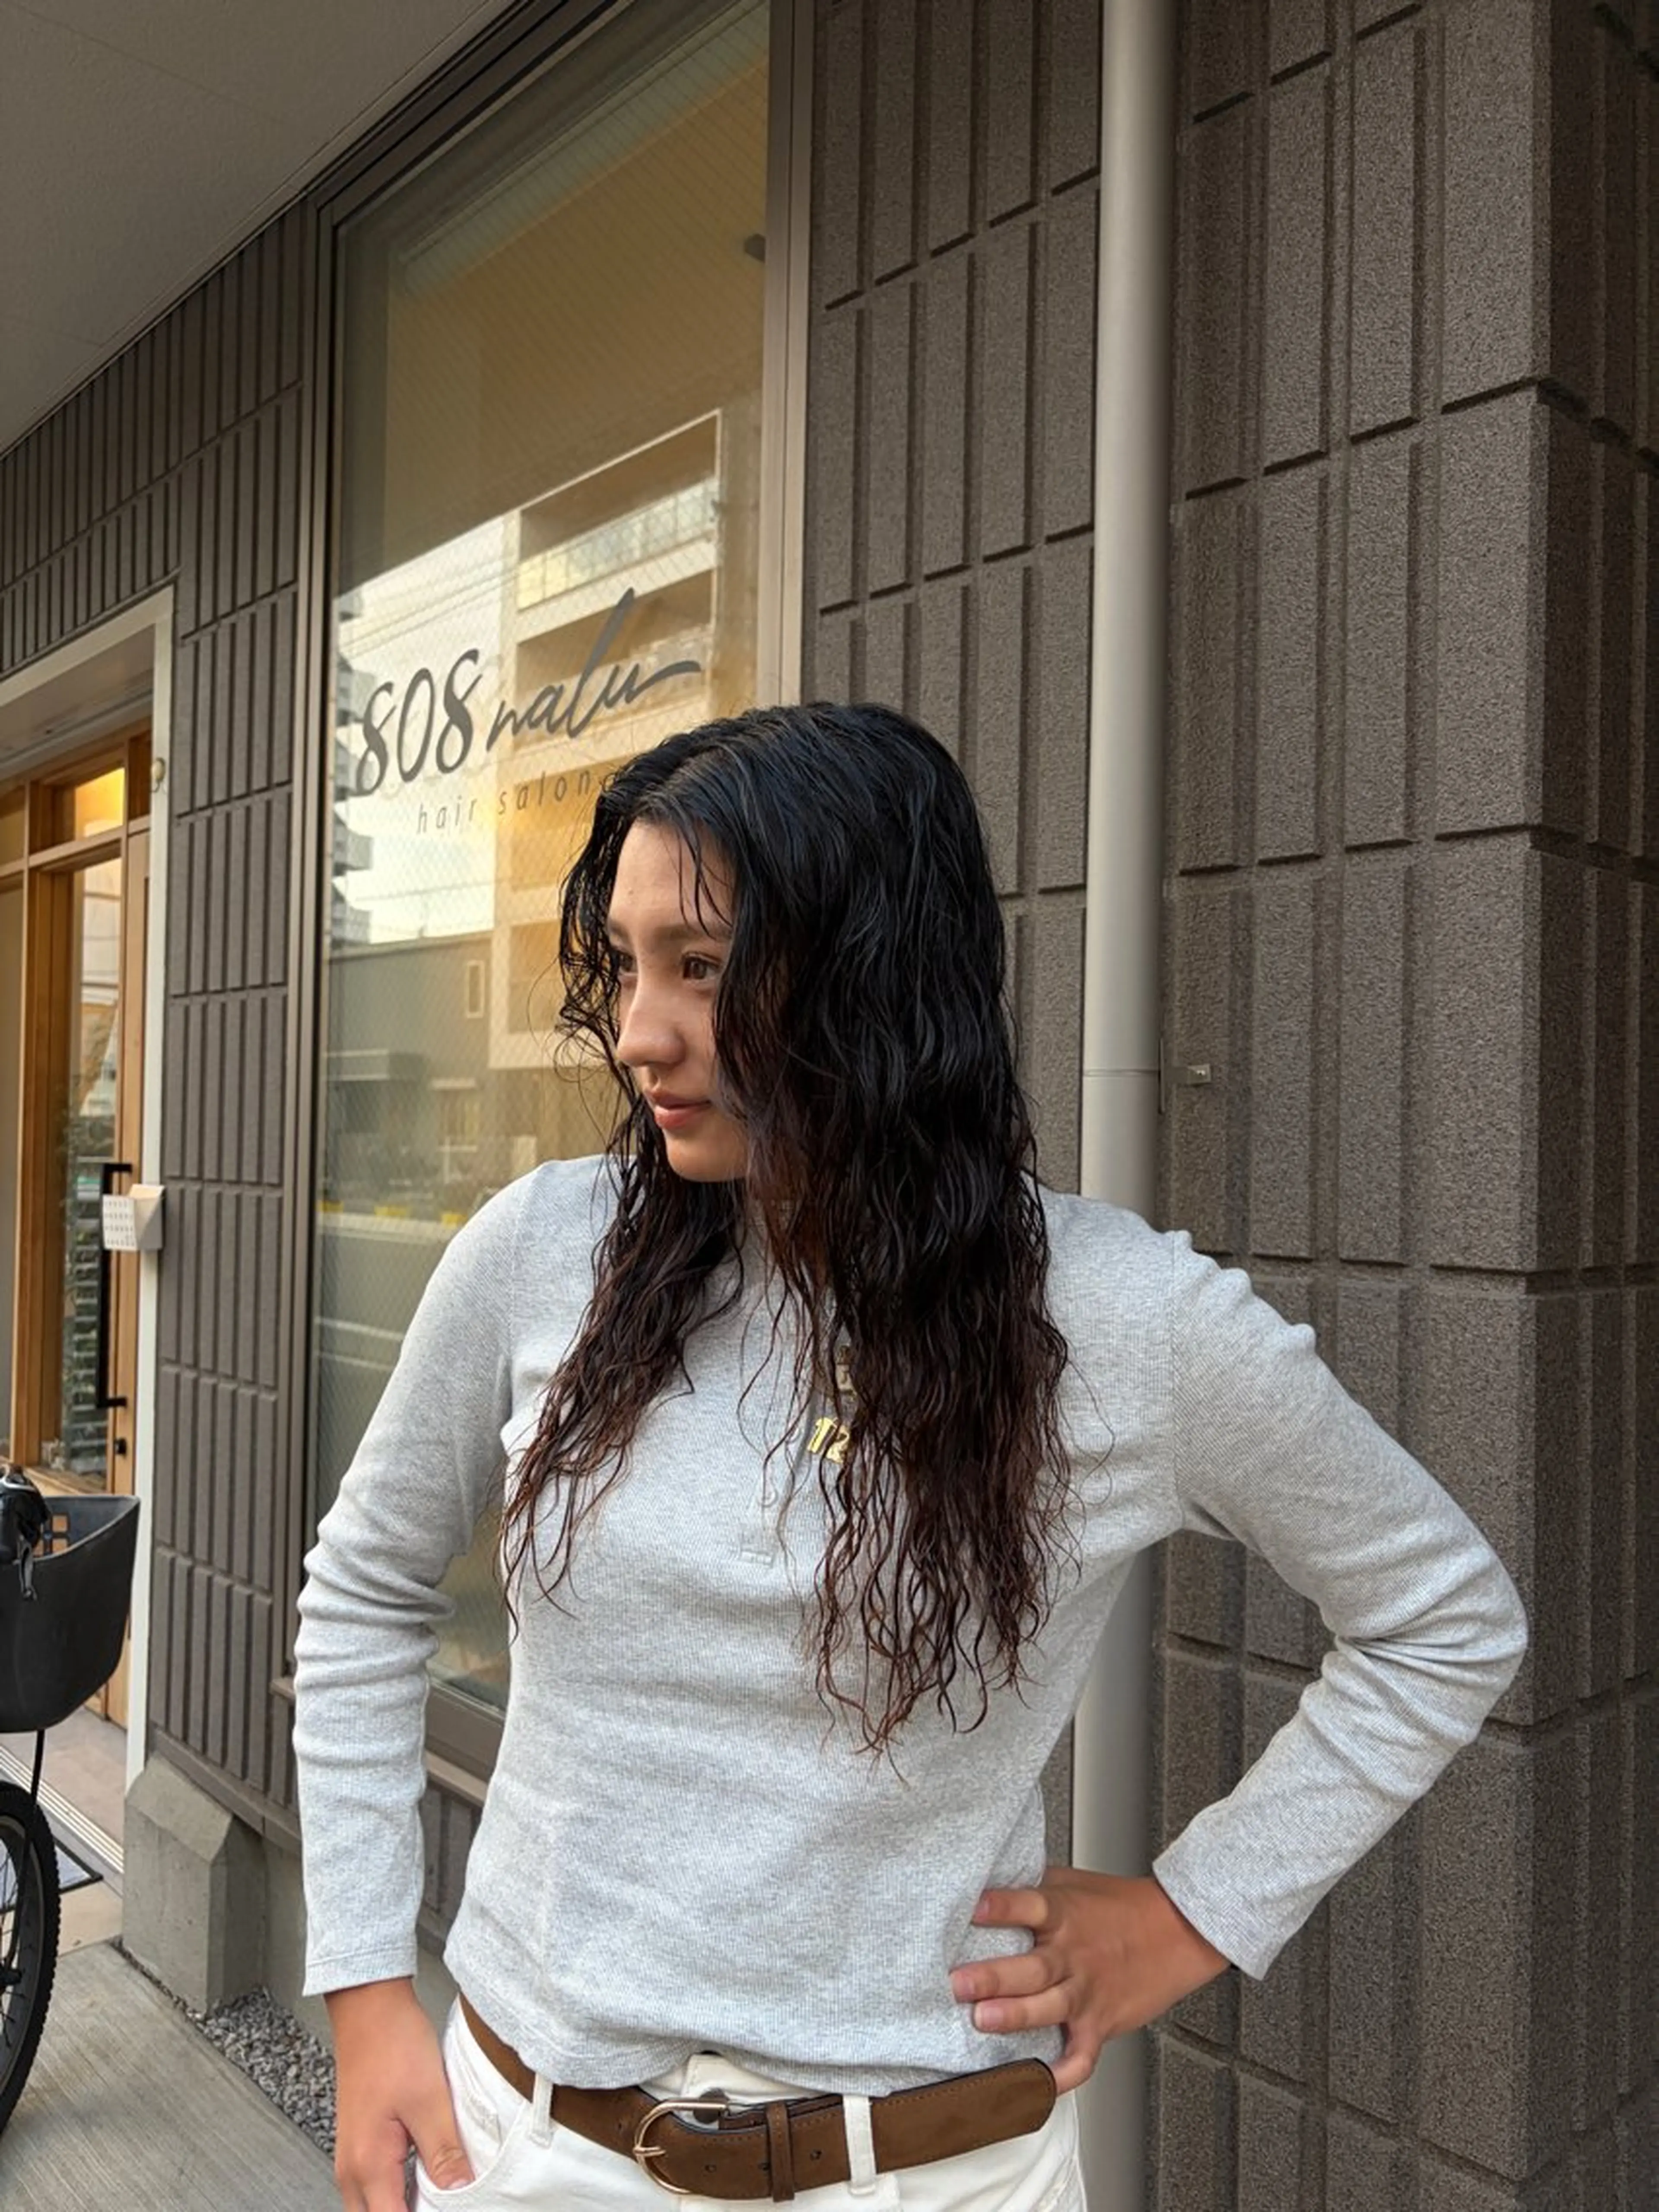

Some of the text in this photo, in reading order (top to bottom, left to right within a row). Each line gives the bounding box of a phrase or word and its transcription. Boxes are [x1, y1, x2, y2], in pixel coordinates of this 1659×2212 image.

[356, 587, 701, 796] 808 nalu
[418, 769, 590, 834] hair salon
